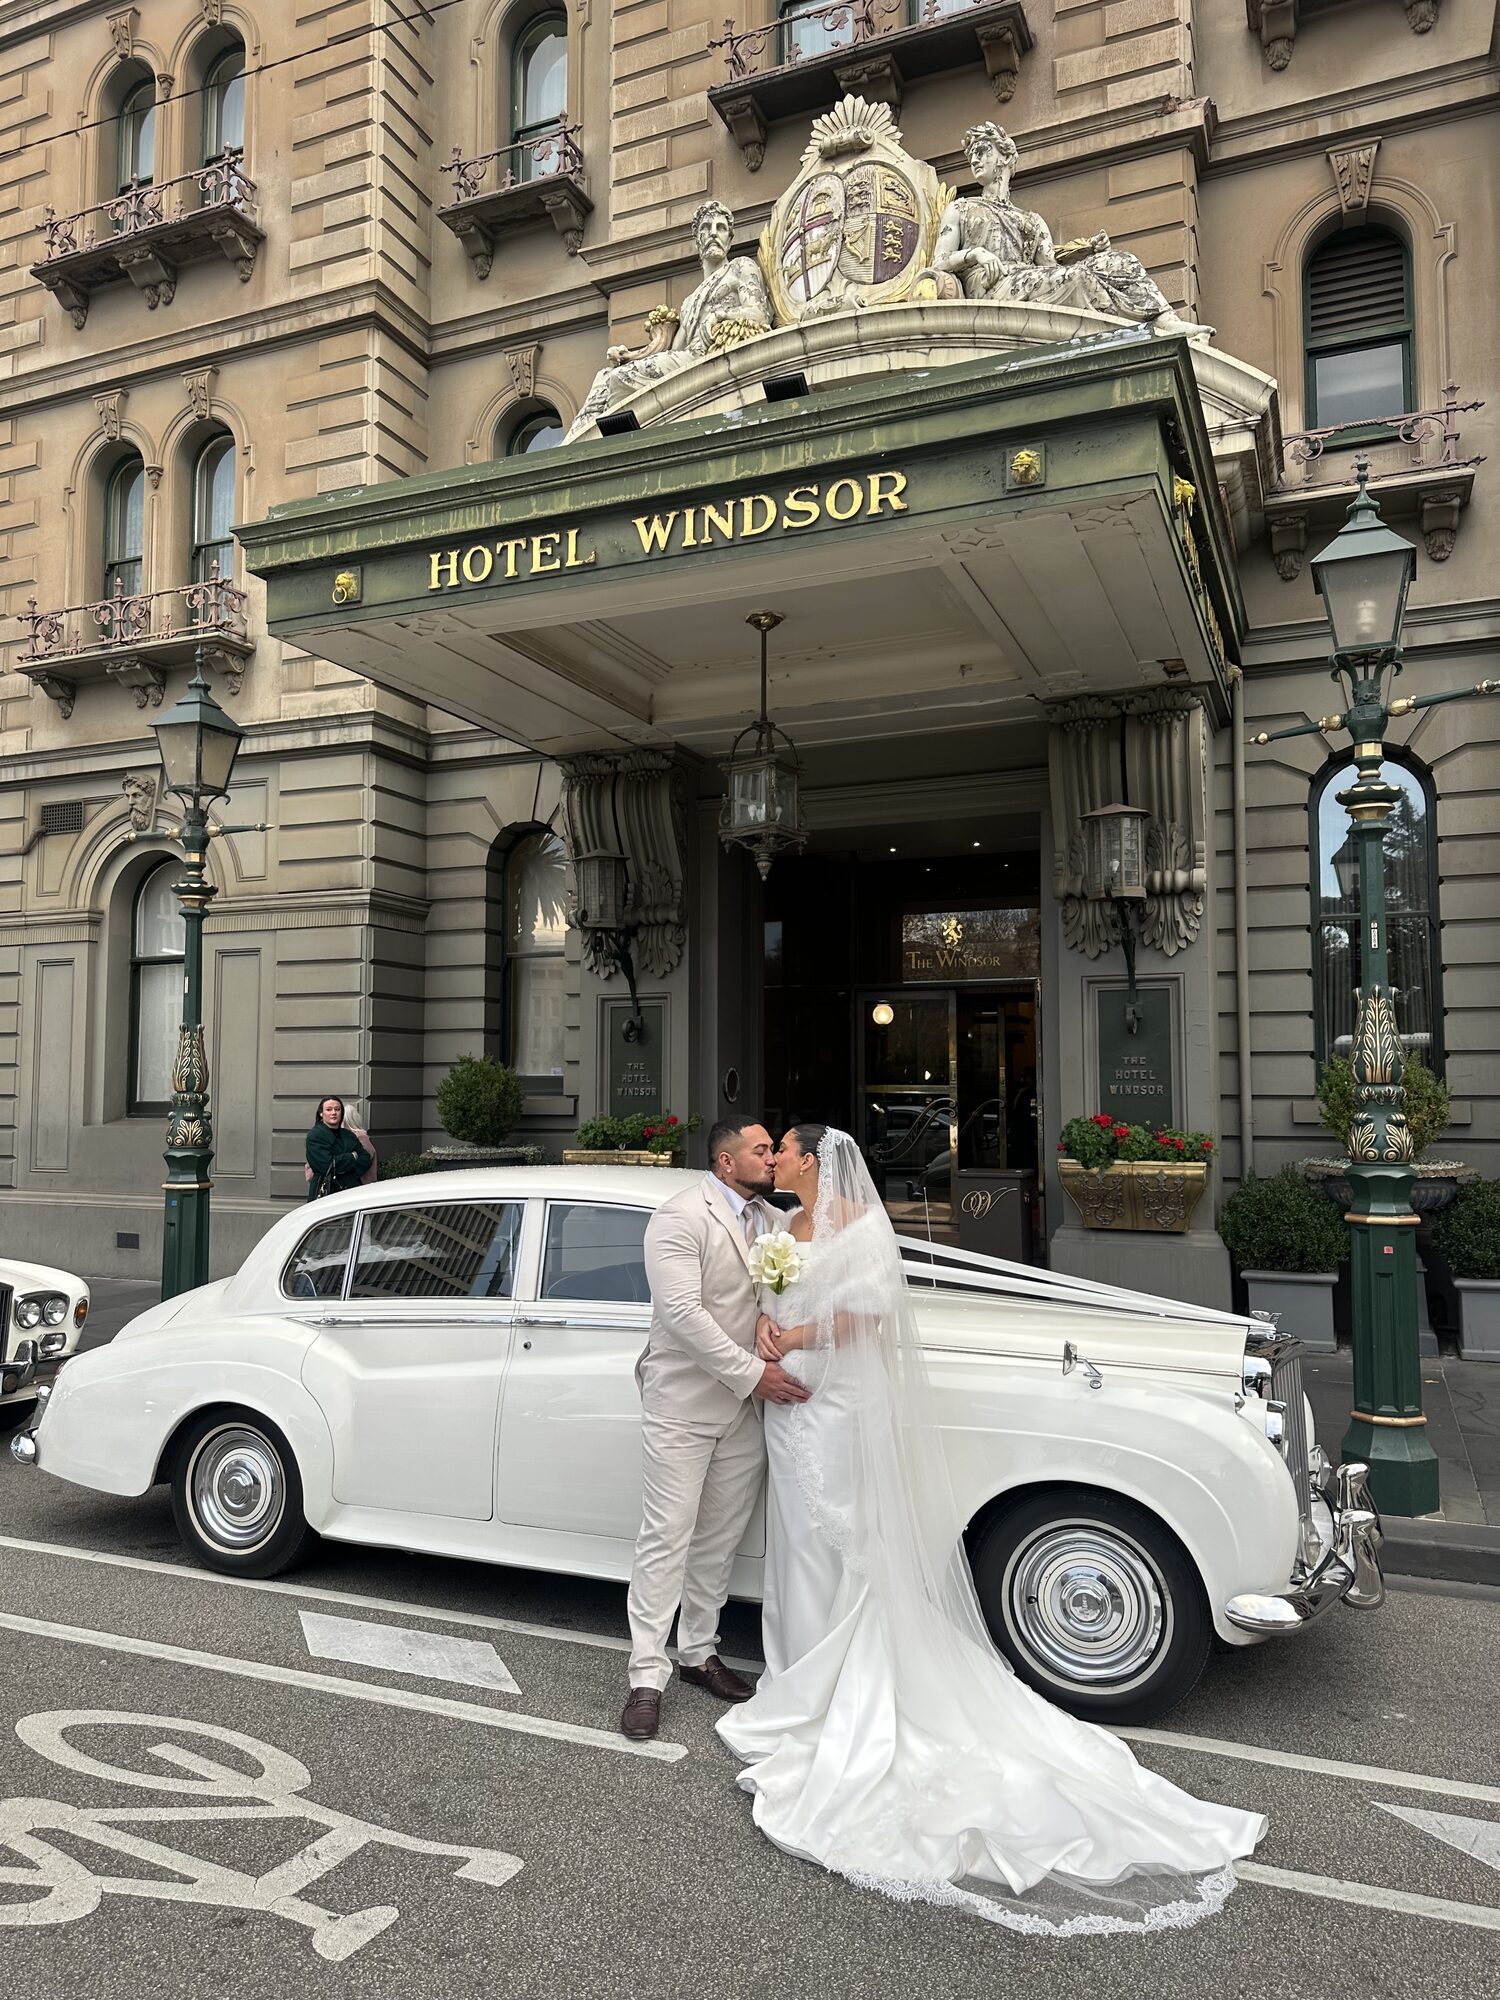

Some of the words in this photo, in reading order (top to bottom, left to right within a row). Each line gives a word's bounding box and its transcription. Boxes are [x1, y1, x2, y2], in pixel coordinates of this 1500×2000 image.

[428, 528, 597, 591] HOTEL
[633, 471, 909, 555] WINDSOR
[1122, 1056, 1147, 1065] THE
[627, 1062, 646, 1070] THE
[621, 1074, 651, 1083] HOTEL
[1115, 1069, 1157, 1080] HOTEL
[616, 1087, 657, 1096] WINDSOR
[1109, 1084, 1165, 1095] WINDSOR
